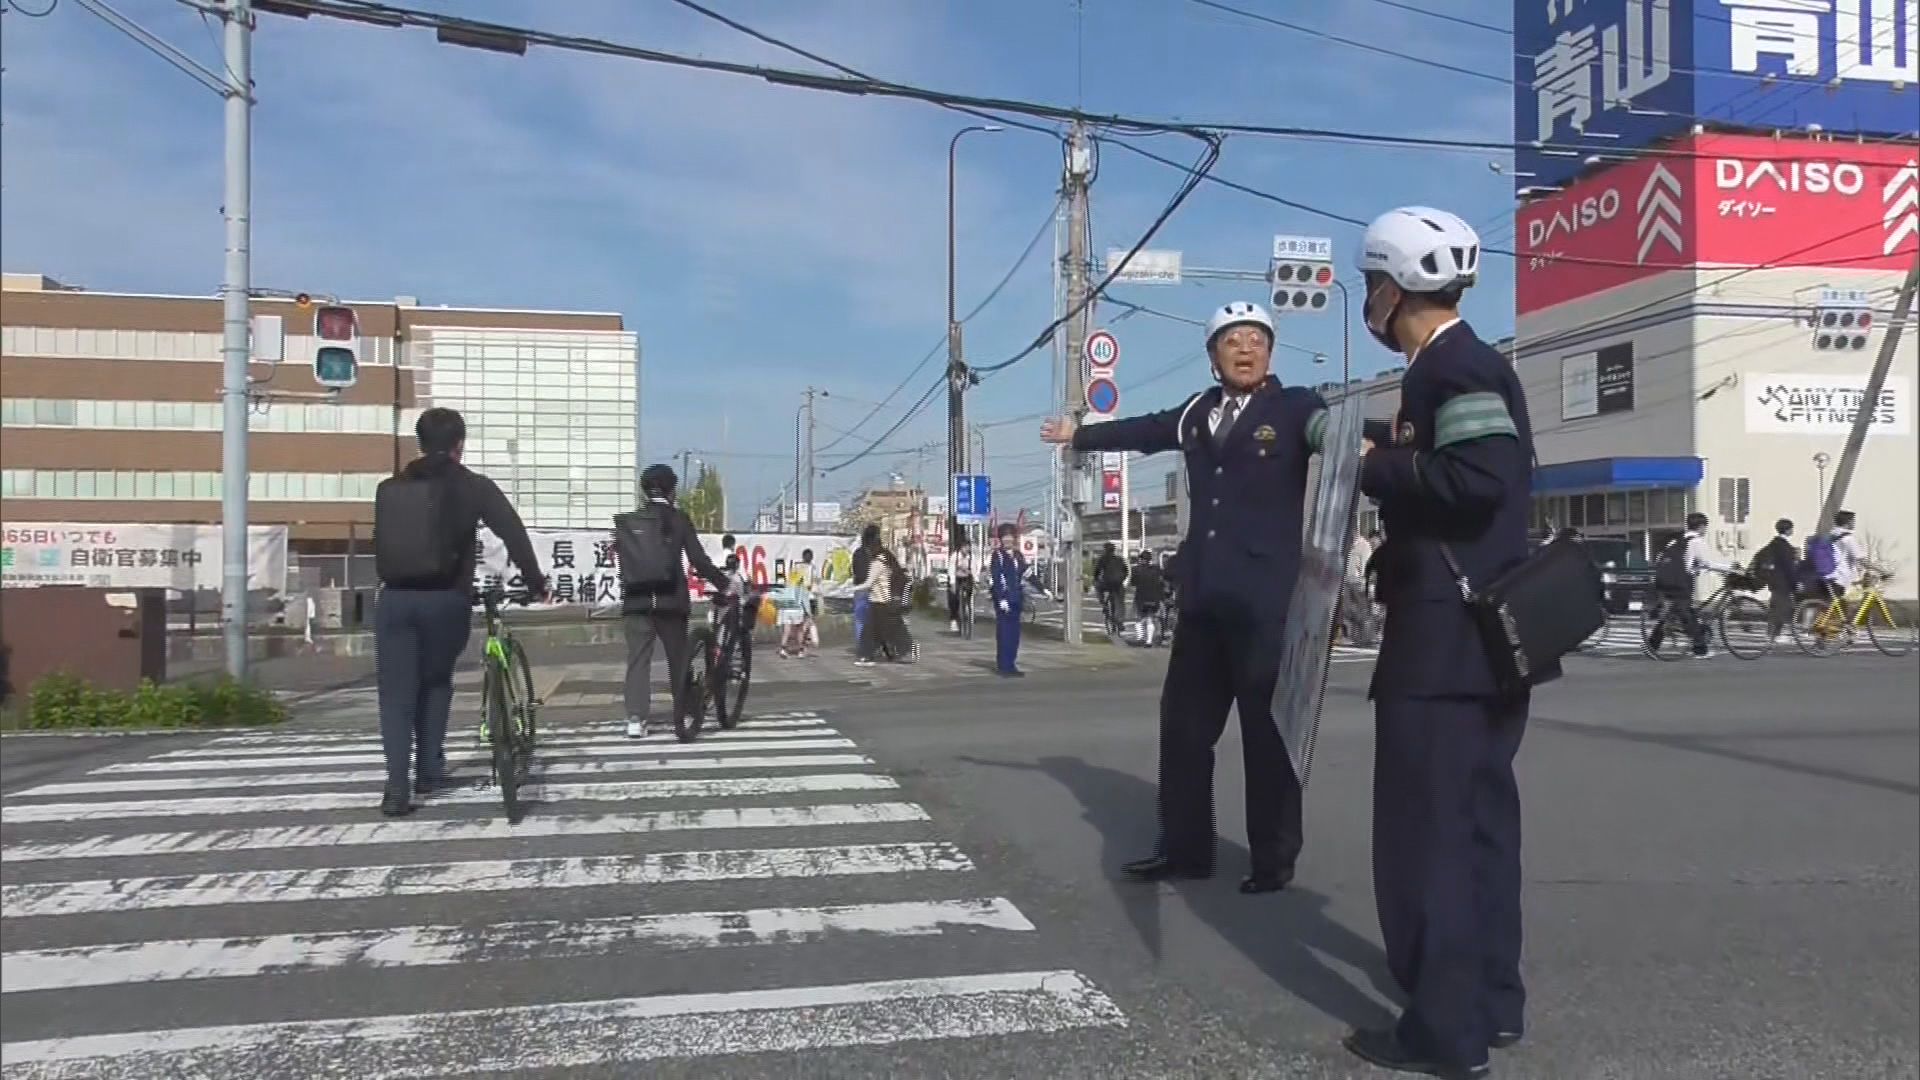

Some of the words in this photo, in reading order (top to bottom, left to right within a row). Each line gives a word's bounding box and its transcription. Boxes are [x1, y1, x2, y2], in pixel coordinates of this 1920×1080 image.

[1531, 0, 1670, 142] 青山
[1716, 159, 1863, 195] DAISO
[1529, 188, 1620, 249] DAISO
[1718, 200, 1776, 217] ダイソー
[1094, 341, 1112, 358] 40
[71, 548, 202, 568] 自衛官募集中
